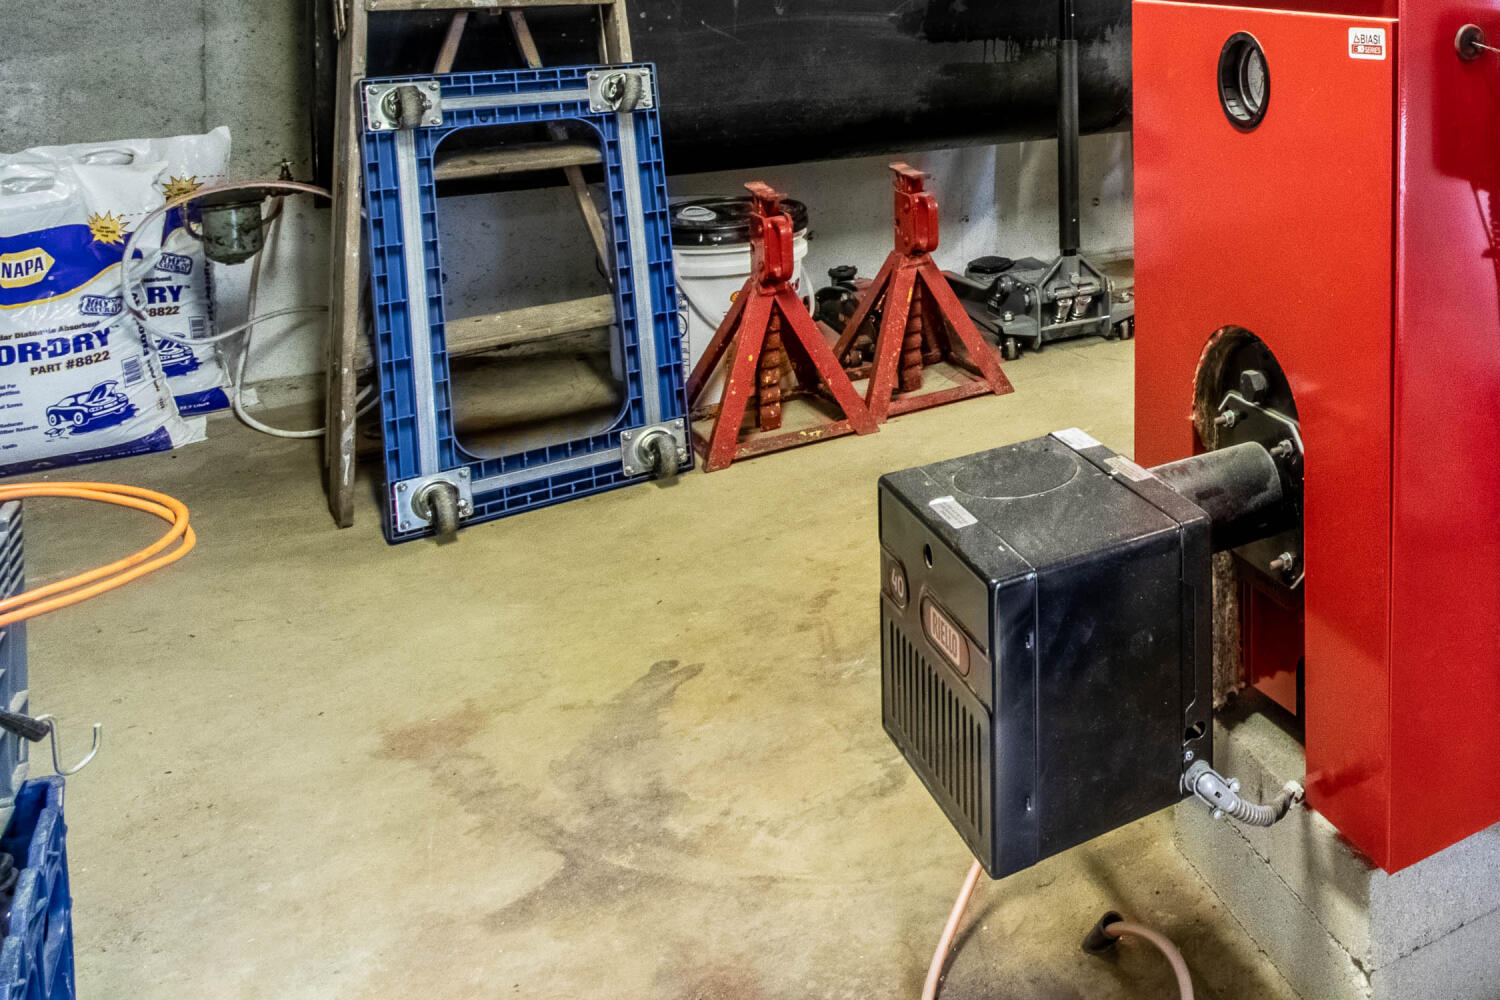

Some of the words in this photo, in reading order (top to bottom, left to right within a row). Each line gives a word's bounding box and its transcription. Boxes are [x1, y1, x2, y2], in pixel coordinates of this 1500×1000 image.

[1360, 34, 1381, 45] BIASI
[1, 256, 45, 279] NAPA
[30, 362, 63, 377] PART
[66, 350, 111, 370] #8822
[890, 568, 905, 598] 40
[931, 609, 960, 665] RIELLO
